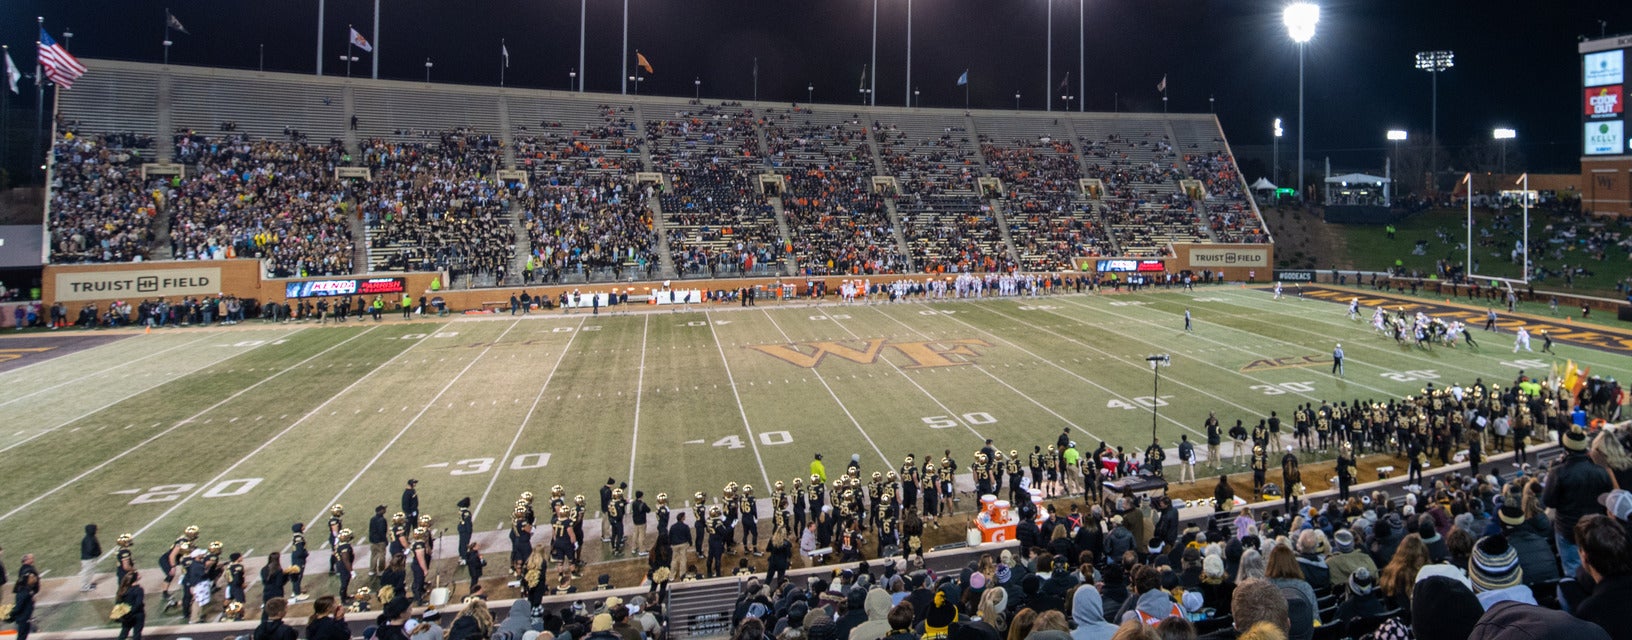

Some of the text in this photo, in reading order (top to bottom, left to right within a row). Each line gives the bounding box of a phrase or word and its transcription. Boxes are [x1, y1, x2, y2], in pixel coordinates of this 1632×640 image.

[1590, 95, 1617, 105] COOK
[1594, 104, 1613, 113] OUT
[1237, 254, 1261, 262] FIELD
[1279, 272, 1311, 280] #GODEACS
[70, 277, 209, 292] TRUIST FIELD
[314, 281, 355, 289] KENDA
[741, 337, 997, 369] WF
[1242, 353, 1334, 370] ACC
[1249, 381, 1315, 395] 30
[1106, 396, 1170, 409] 40
[921, 411, 999, 429] 50
[711, 430, 794, 449] 40
[449, 452, 552, 475] 30
[977, 469, 988, 480] 73
[127, 477, 264, 505] 20
[741, 501, 751, 513] 16
[553, 524, 564, 537] 77
[883, 521, 890, 534] 6
[992, 529, 1006, 543] G
